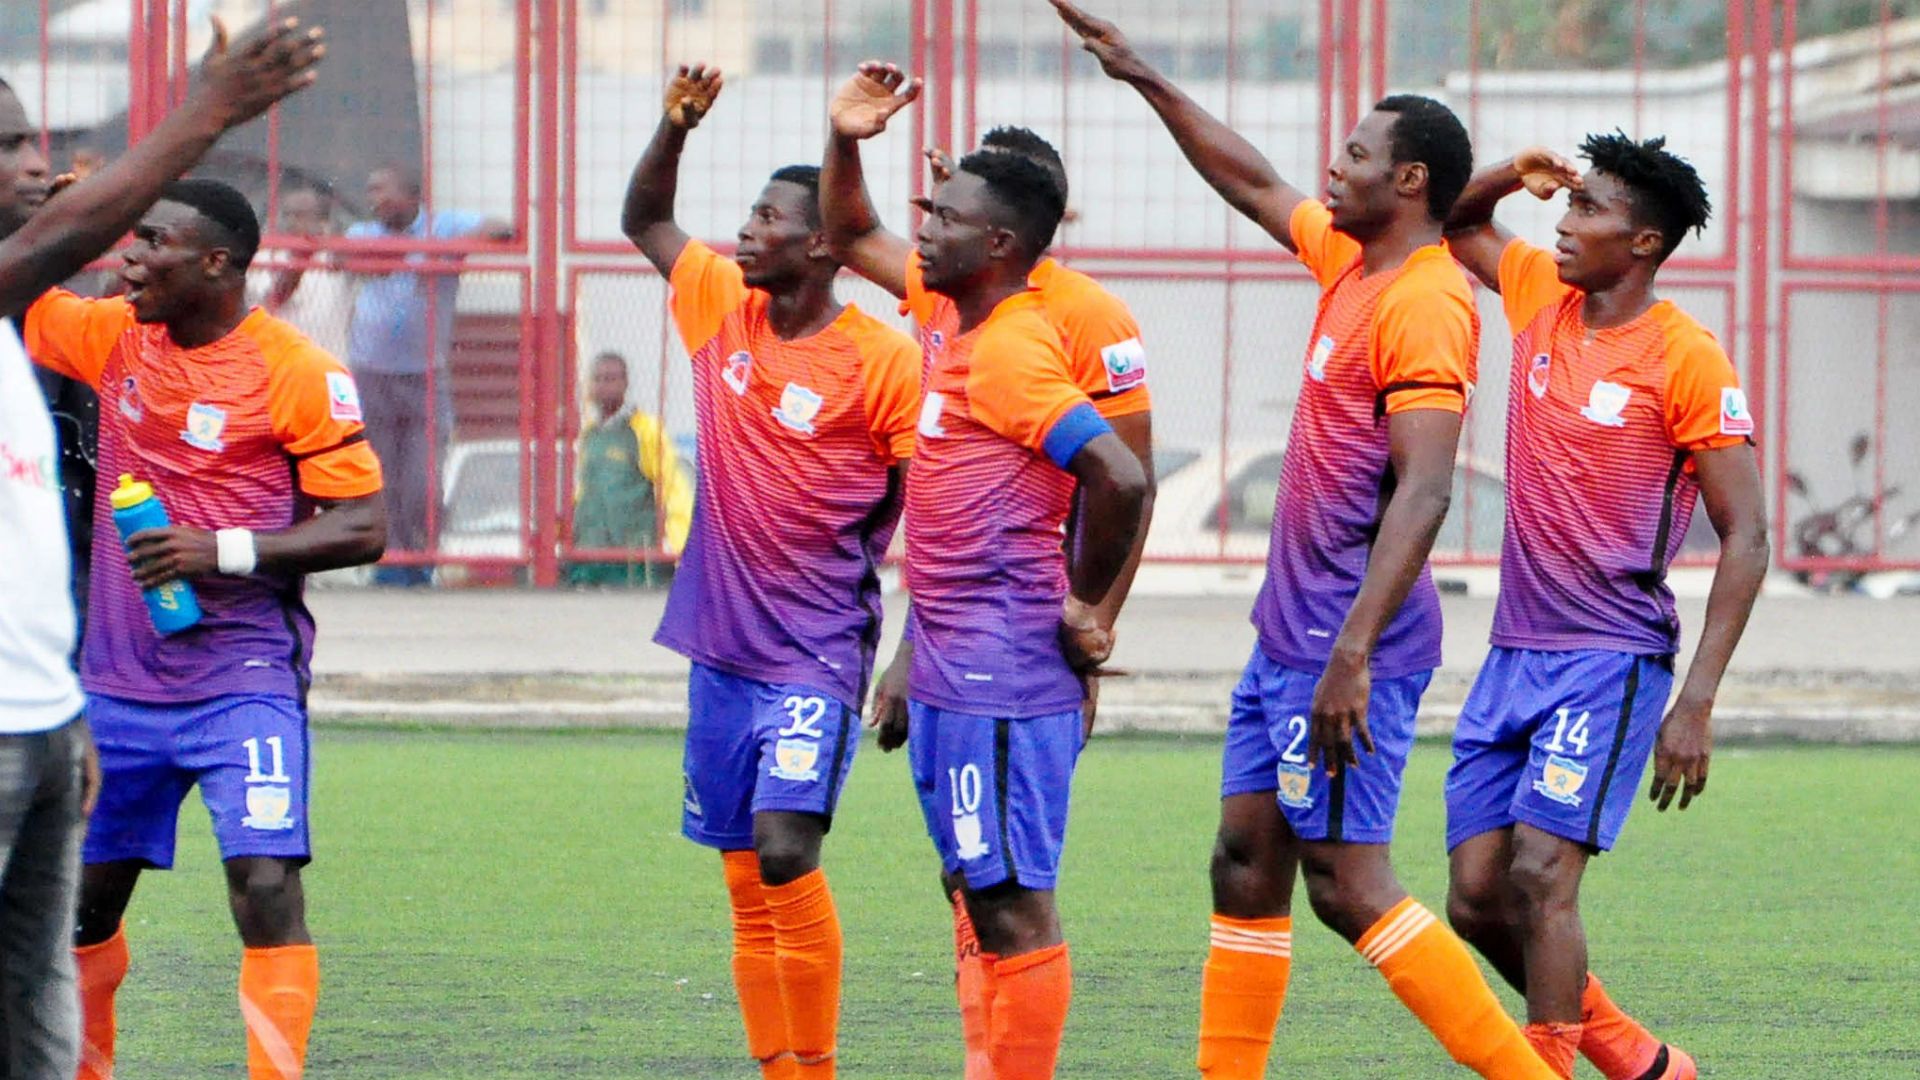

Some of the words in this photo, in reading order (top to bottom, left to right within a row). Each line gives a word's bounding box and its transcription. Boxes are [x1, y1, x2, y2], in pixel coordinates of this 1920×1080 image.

[779, 696, 825, 736] 32
[1282, 716, 1307, 762] 2
[1544, 708, 1589, 754] 14
[242, 736, 290, 782] 11
[949, 763, 981, 815] 10
